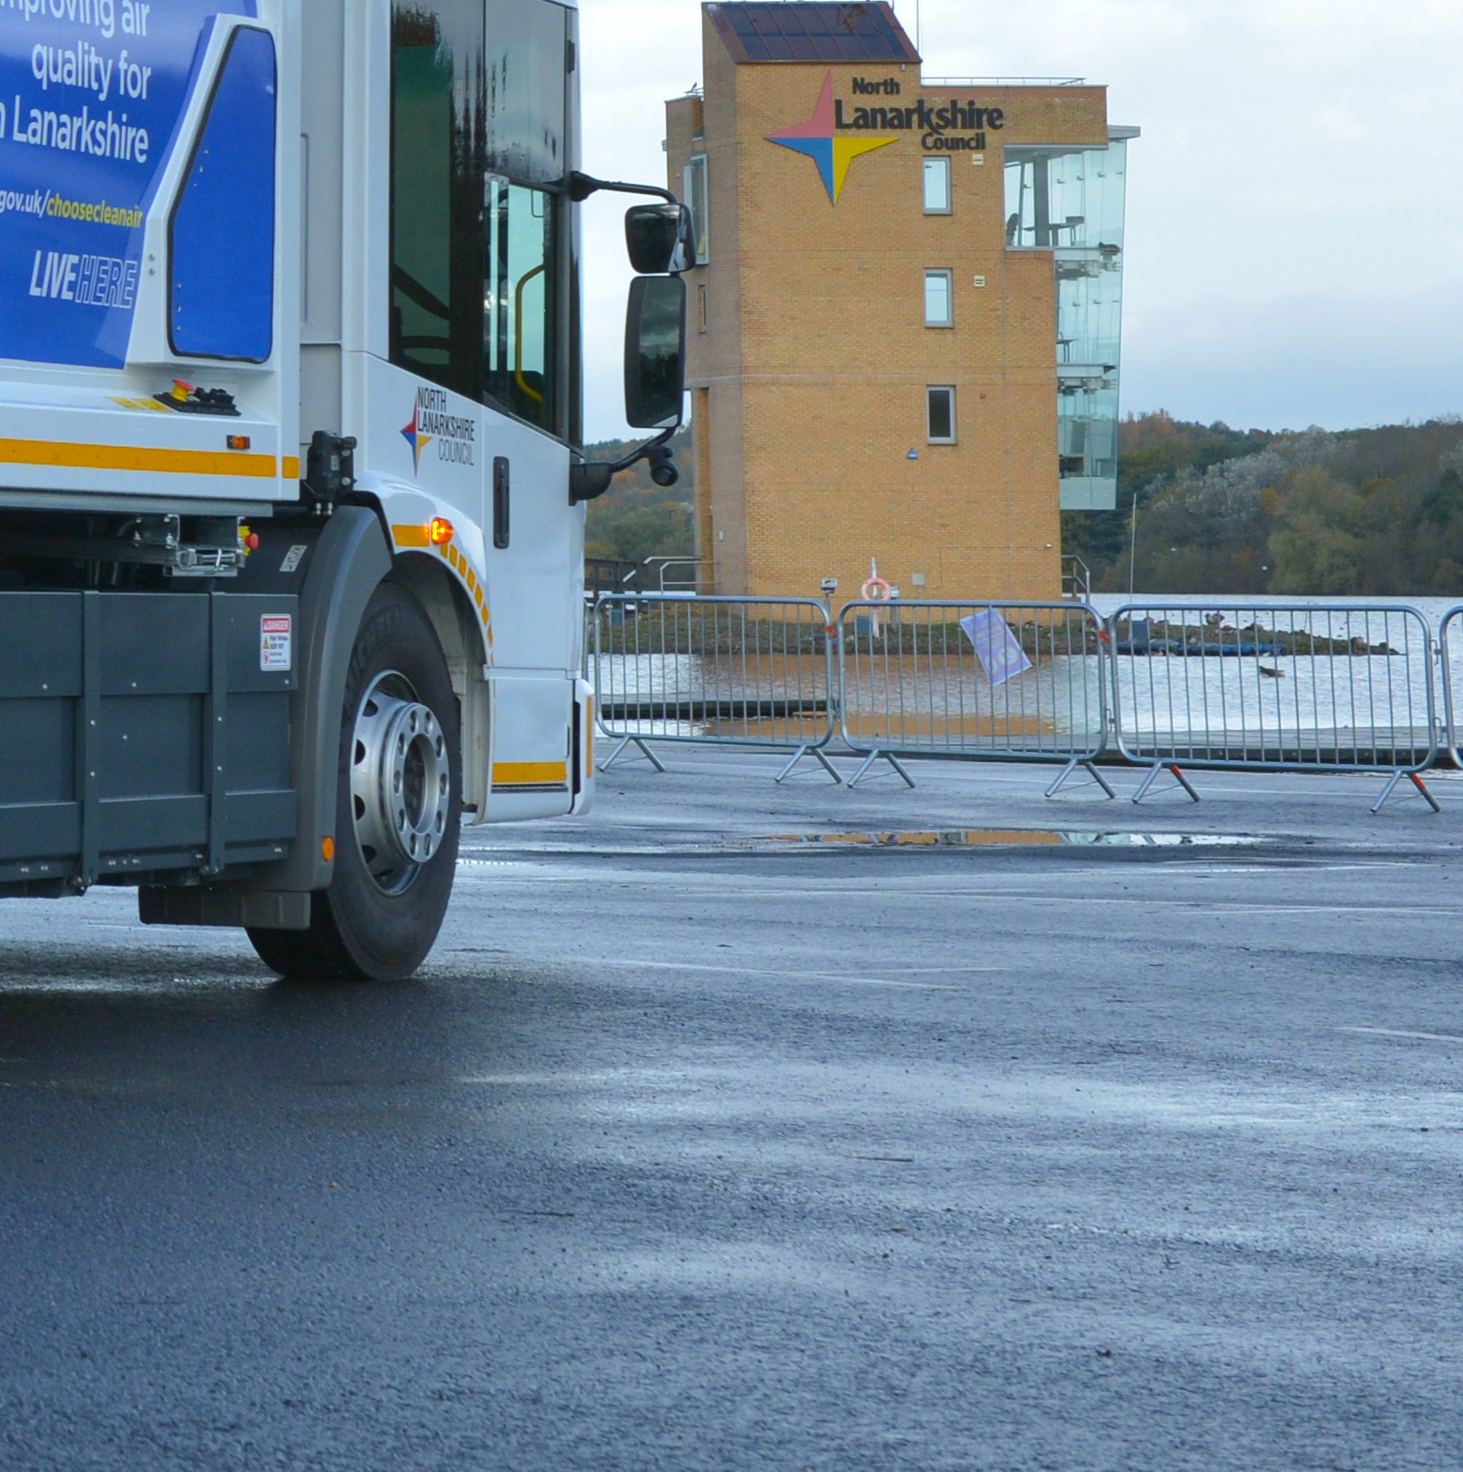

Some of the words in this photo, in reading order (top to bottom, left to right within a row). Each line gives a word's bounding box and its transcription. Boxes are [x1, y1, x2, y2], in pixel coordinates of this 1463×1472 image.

[31, 40, 113, 102] quality
[118, 49, 152, 100] for
[852, 77, 901, 96] North
[12, 94, 150, 164] Lanarkshire
[834, 99, 1005, 136] Lanarkshire
[921, 132, 987, 151] Council
[416, 386, 447, 412] NORTH
[416, 409, 475, 442] LANARKSHIRE
[438, 438, 474, 467] COUNCIL
